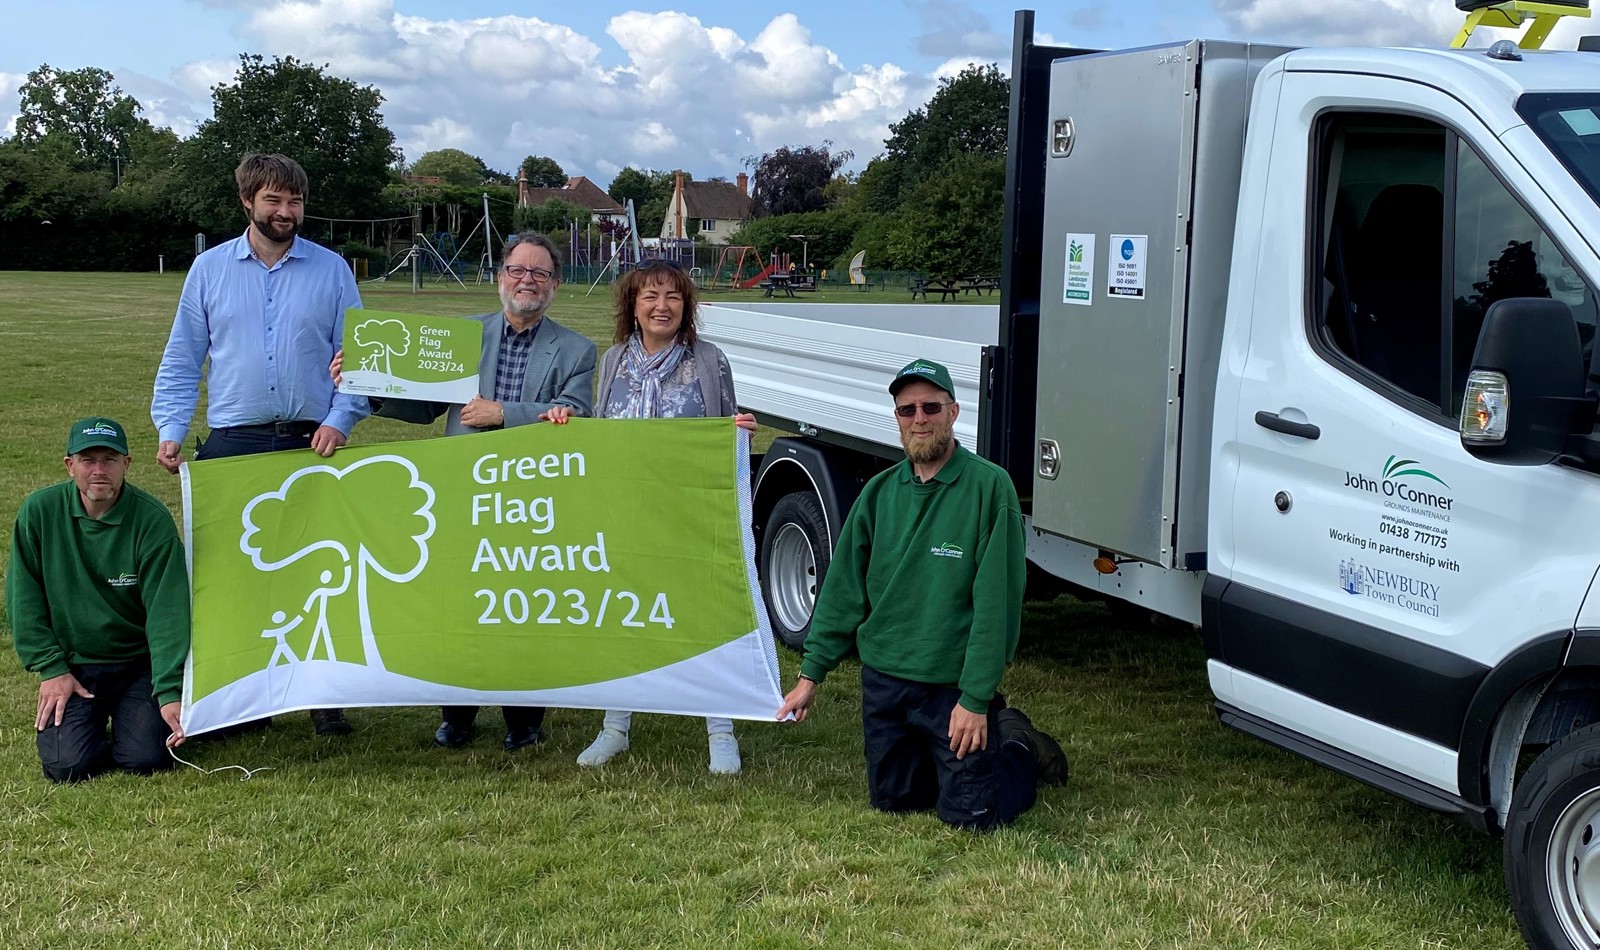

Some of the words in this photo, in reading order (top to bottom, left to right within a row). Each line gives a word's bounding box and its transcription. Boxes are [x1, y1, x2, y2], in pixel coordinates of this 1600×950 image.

[1114, 287, 1138, 295] Registered
[419, 336, 441, 349] Flag
[420, 325, 451, 337] Green
[417, 360, 464, 373] 2023/24
[418, 348, 452, 359] Award
[472, 451, 586, 485] Green
[1344, 471, 1378, 493] John
[1382, 480, 1453, 510] O'Conner
[471, 492, 556, 534] Flag
[1381, 514, 1448, 535] www.johnoconner.co.uk
[1383, 501, 1411, 513] GROUNDS
[1410, 508, 1451, 522] MAINTENANCE
[1329, 528, 1367, 549] Working
[1368, 538, 1377, 549] in
[1379, 544, 1436, 568] partnership
[1437, 559, 1460, 572] with
[1379, 522, 1410, 539] 01438
[1413, 530, 1448, 549] 717175
[471, 532, 611, 573] Award
[1364, 566, 1440, 602] NEWBURY
[474, 588, 675, 629] 2023/24
[1364, 584, 1395, 605] Town
[1397, 594, 1439, 618] Council
